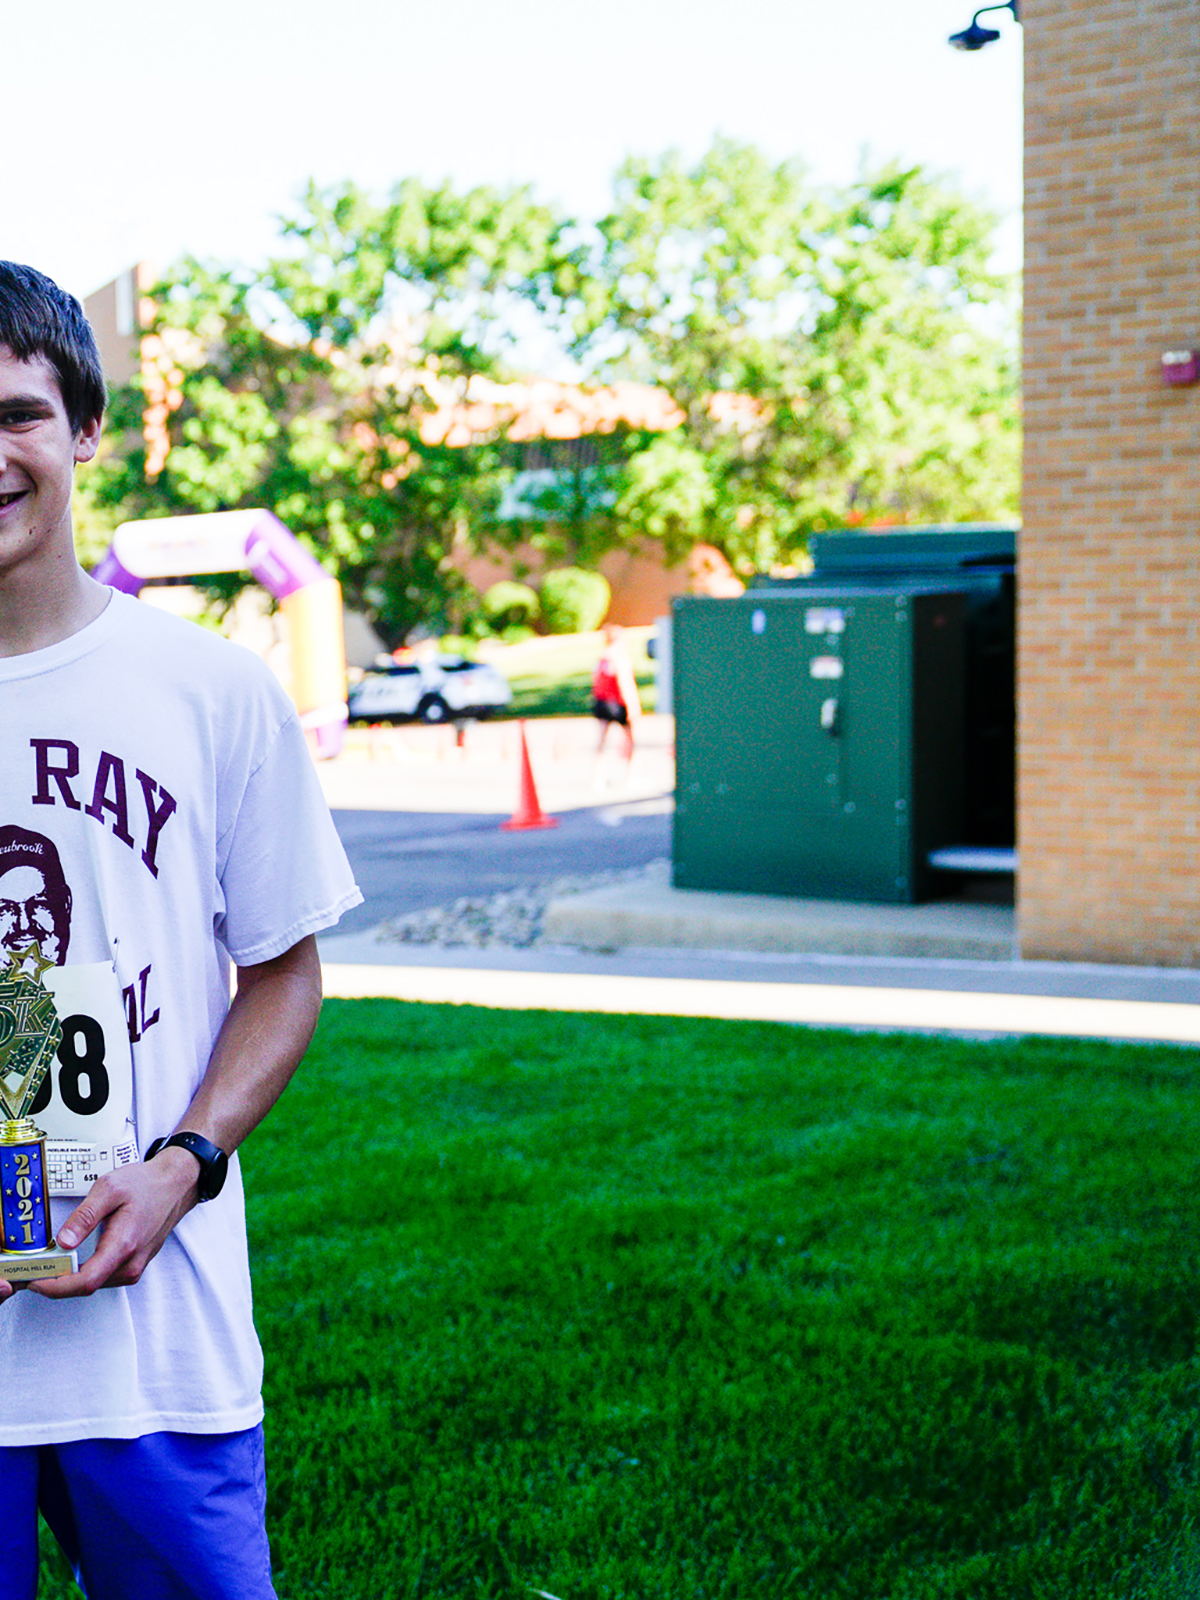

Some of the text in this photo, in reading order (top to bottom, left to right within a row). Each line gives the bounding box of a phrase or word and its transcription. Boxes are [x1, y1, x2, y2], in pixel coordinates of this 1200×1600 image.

[29, 738, 177, 880] RAY
[14, 1153, 35, 1244] 2021
[83, 1173, 99, 1182] 658
[4, 1266, 30, 1274] HOSPITAL
